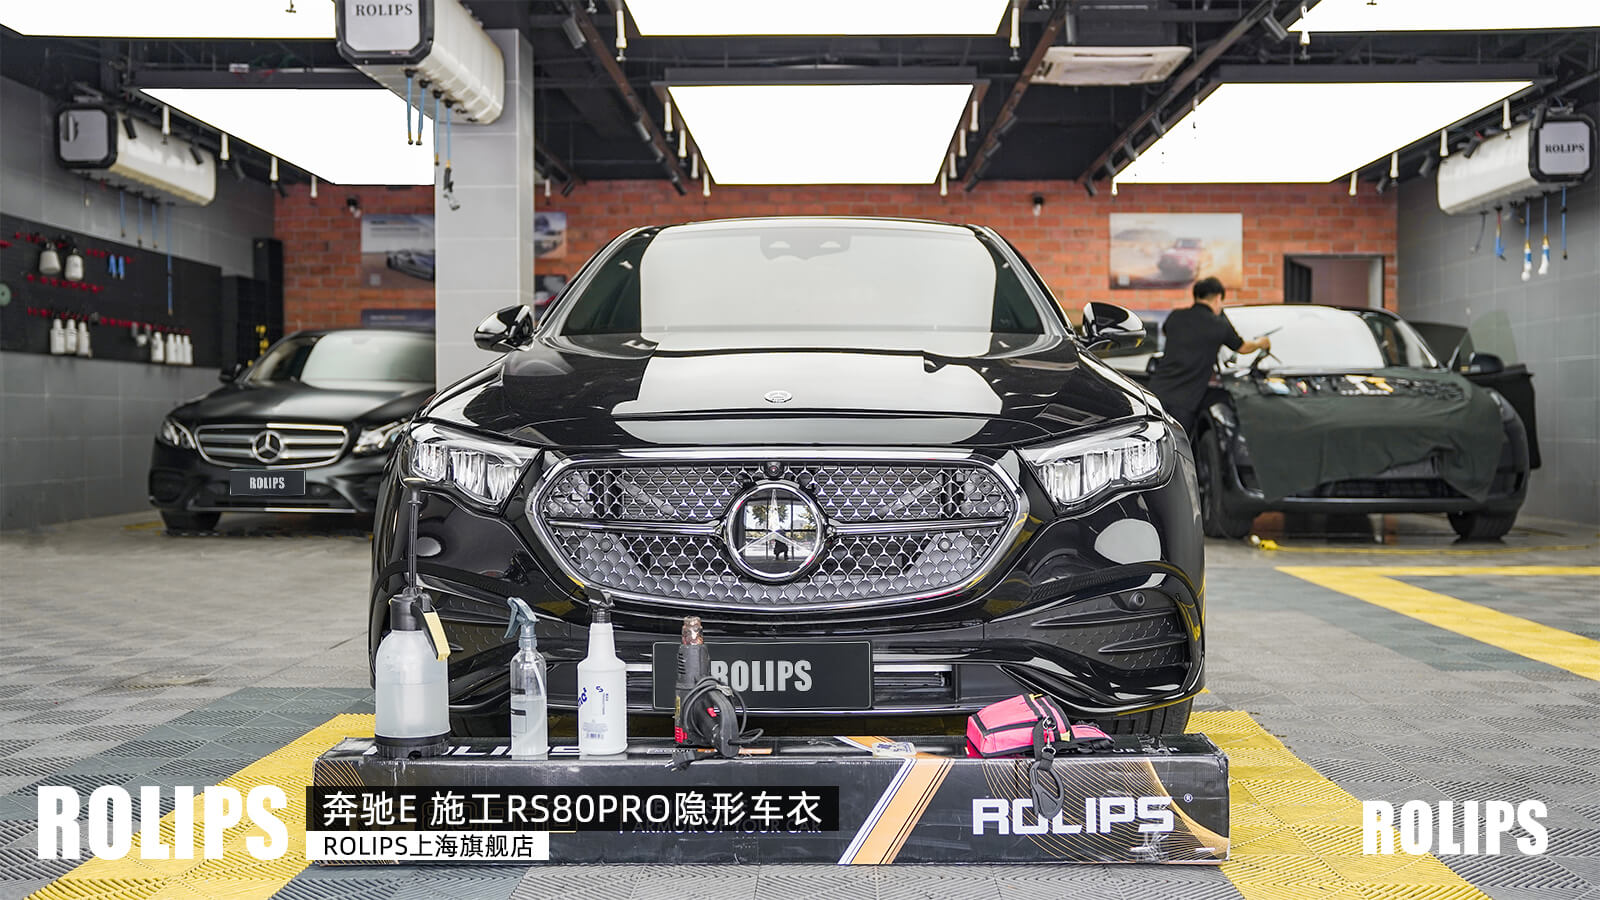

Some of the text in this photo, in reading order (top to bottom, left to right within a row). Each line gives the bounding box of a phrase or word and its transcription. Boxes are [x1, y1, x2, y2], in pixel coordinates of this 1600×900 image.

[355, 3, 413, 17] ROLIPS
[1545, 143, 1585, 153] ROLIPS
[249, 477, 285, 489] ROLIPS
